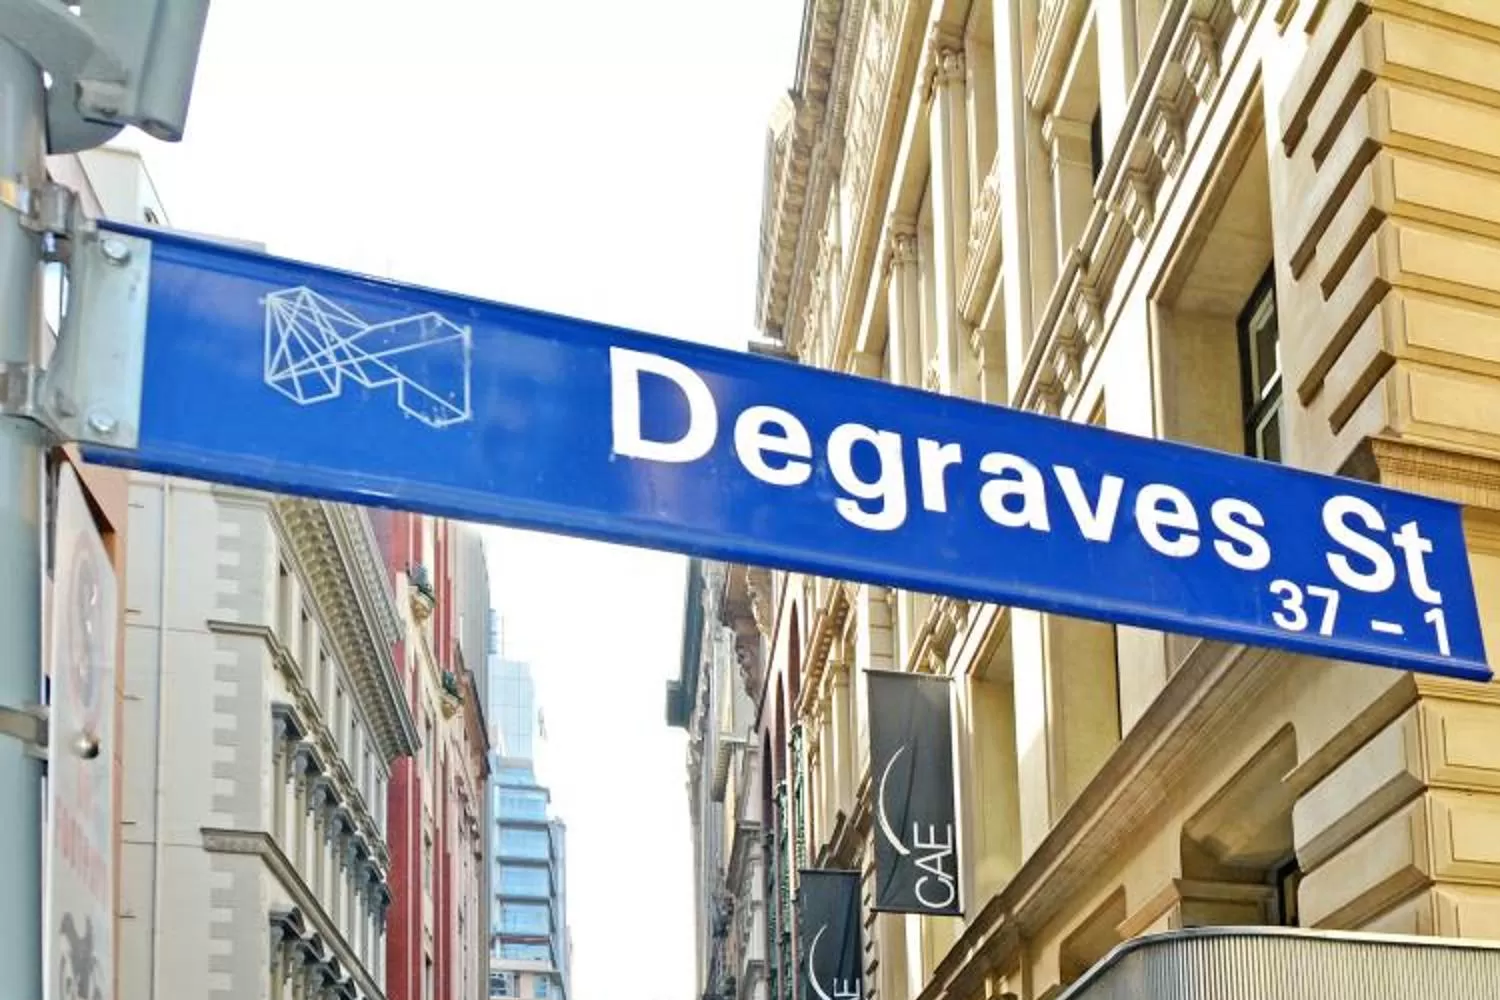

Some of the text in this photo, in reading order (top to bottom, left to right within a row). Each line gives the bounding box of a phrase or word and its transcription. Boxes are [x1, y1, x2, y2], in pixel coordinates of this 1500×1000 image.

[608, 346, 1443, 606] Degraves St
[1268, 578, 1340, 638] 37
[1424, 607, 1452, 658] 1
[912, 821, 956, 909] CAE
